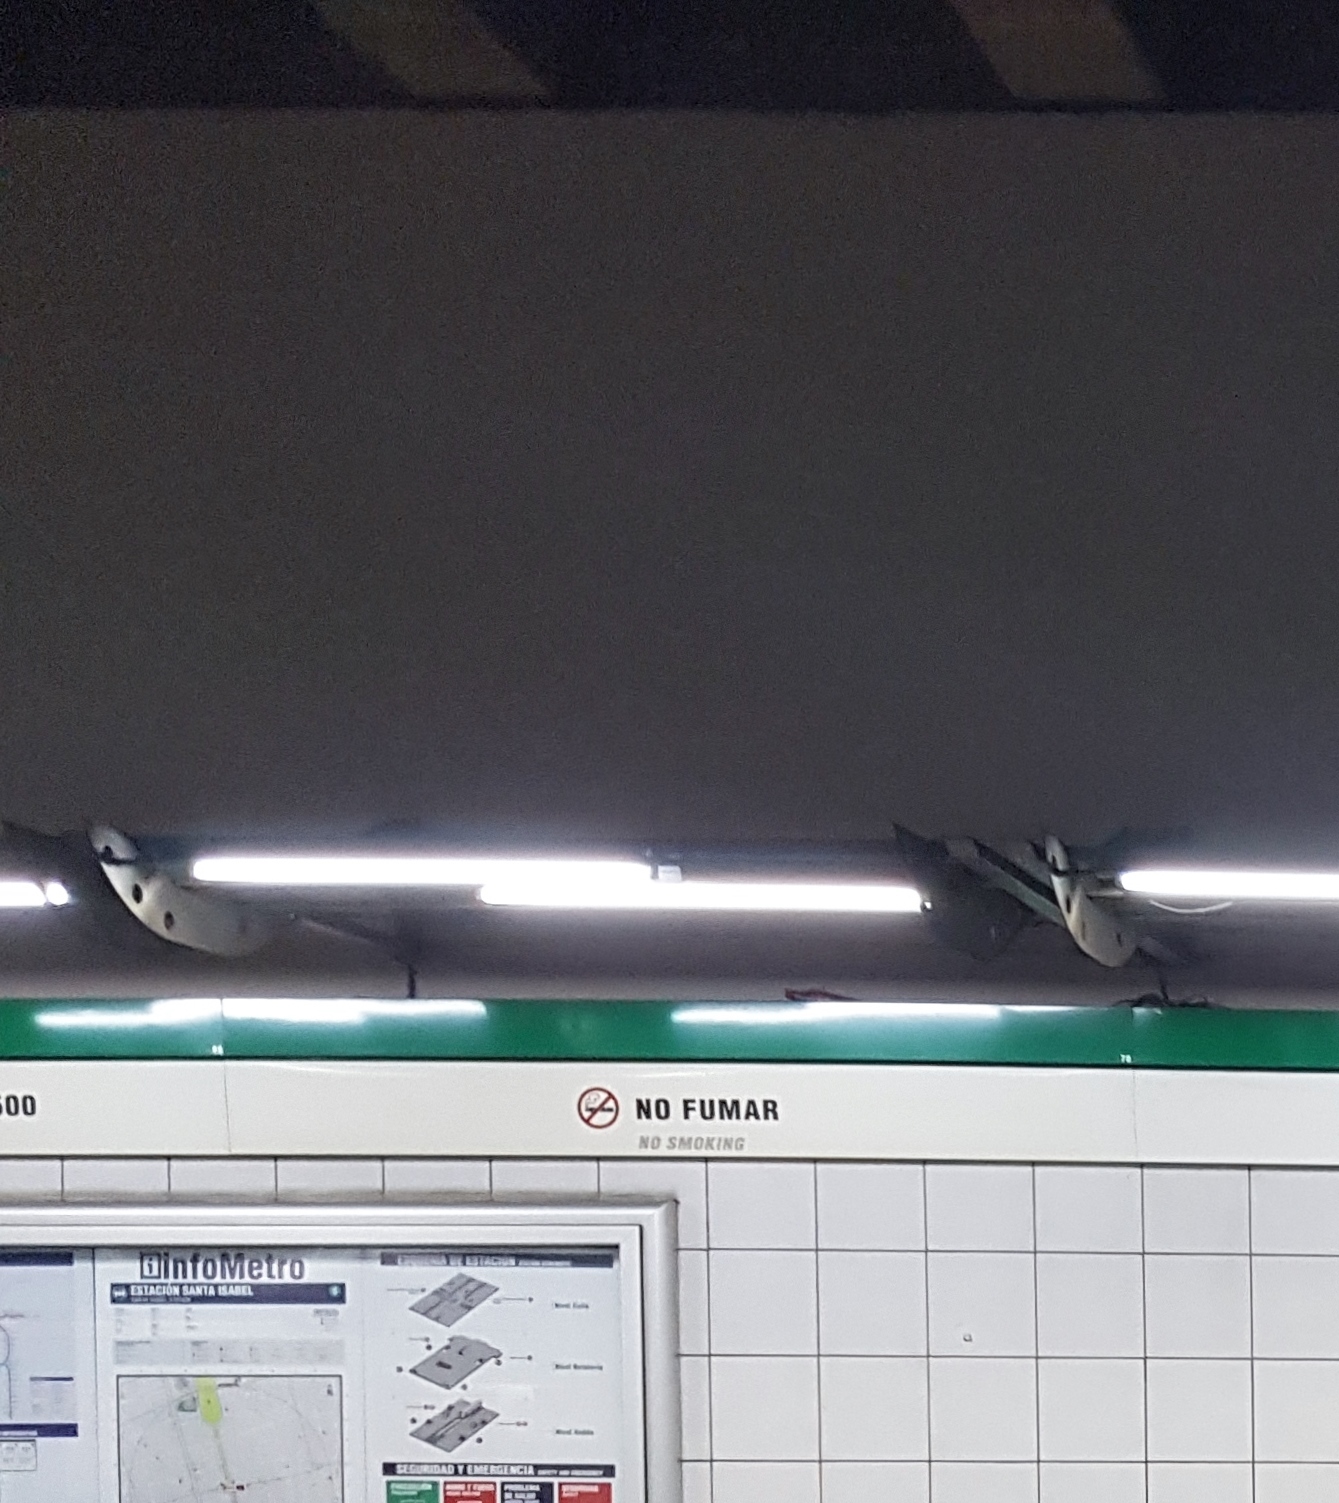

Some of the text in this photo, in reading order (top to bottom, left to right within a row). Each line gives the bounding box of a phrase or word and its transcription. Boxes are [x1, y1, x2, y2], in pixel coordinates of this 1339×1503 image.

[635, 1098, 779, 1121] NO FUMAR
[639, 1135, 745, 1151] NO SMOKING
